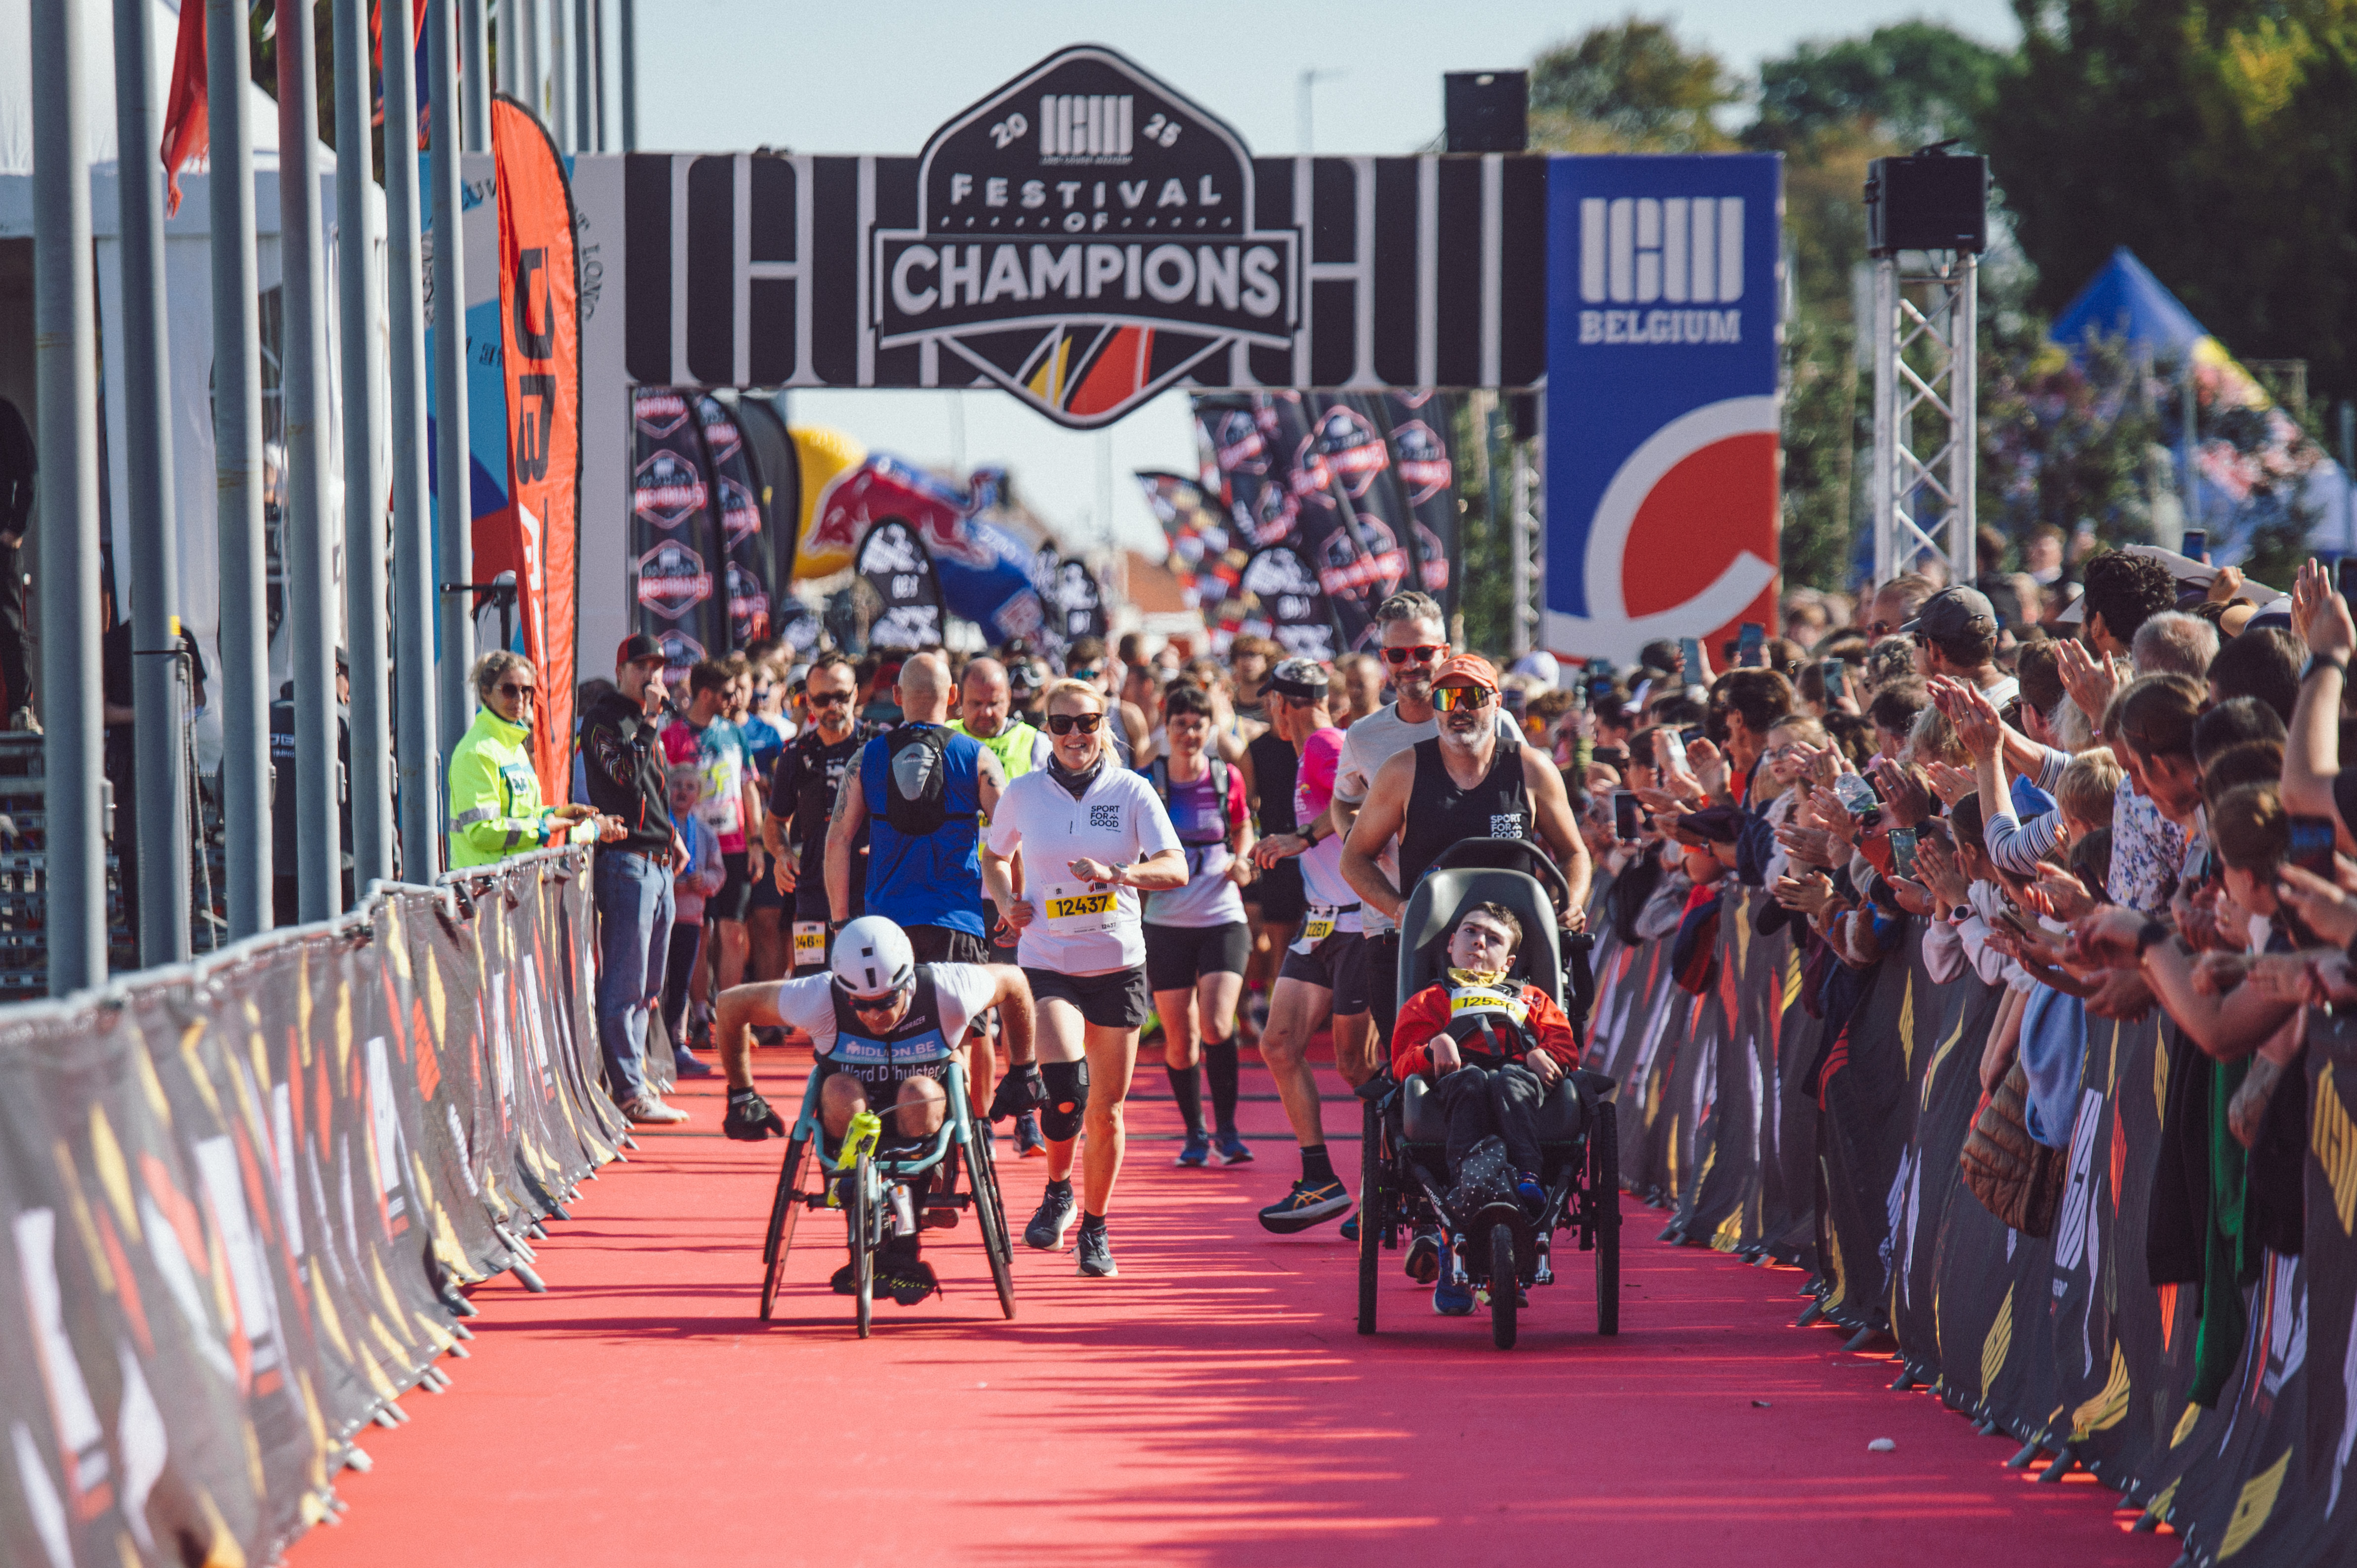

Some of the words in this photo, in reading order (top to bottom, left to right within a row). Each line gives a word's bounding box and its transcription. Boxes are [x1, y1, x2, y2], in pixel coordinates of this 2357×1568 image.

[990, 113, 1028, 149] 20
[1142, 113, 1182, 147] 25
[951, 174, 1221, 208] FESTIVAL
[1063, 212, 1108, 232] OF
[891, 244, 1281, 317] CHAMPIONS
[1578, 310, 1740, 343] BELGIUM
[1490, 813, 1522, 824] SPORT
[1491, 823, 1512, 832] FOR
[1491, 830, 1523, 839] GOOD
[1056, 895, 1108, 917] 12437
[899, 1015, 926, 1032] BIORACER
[841, 1063, 874, 1082] Ward
